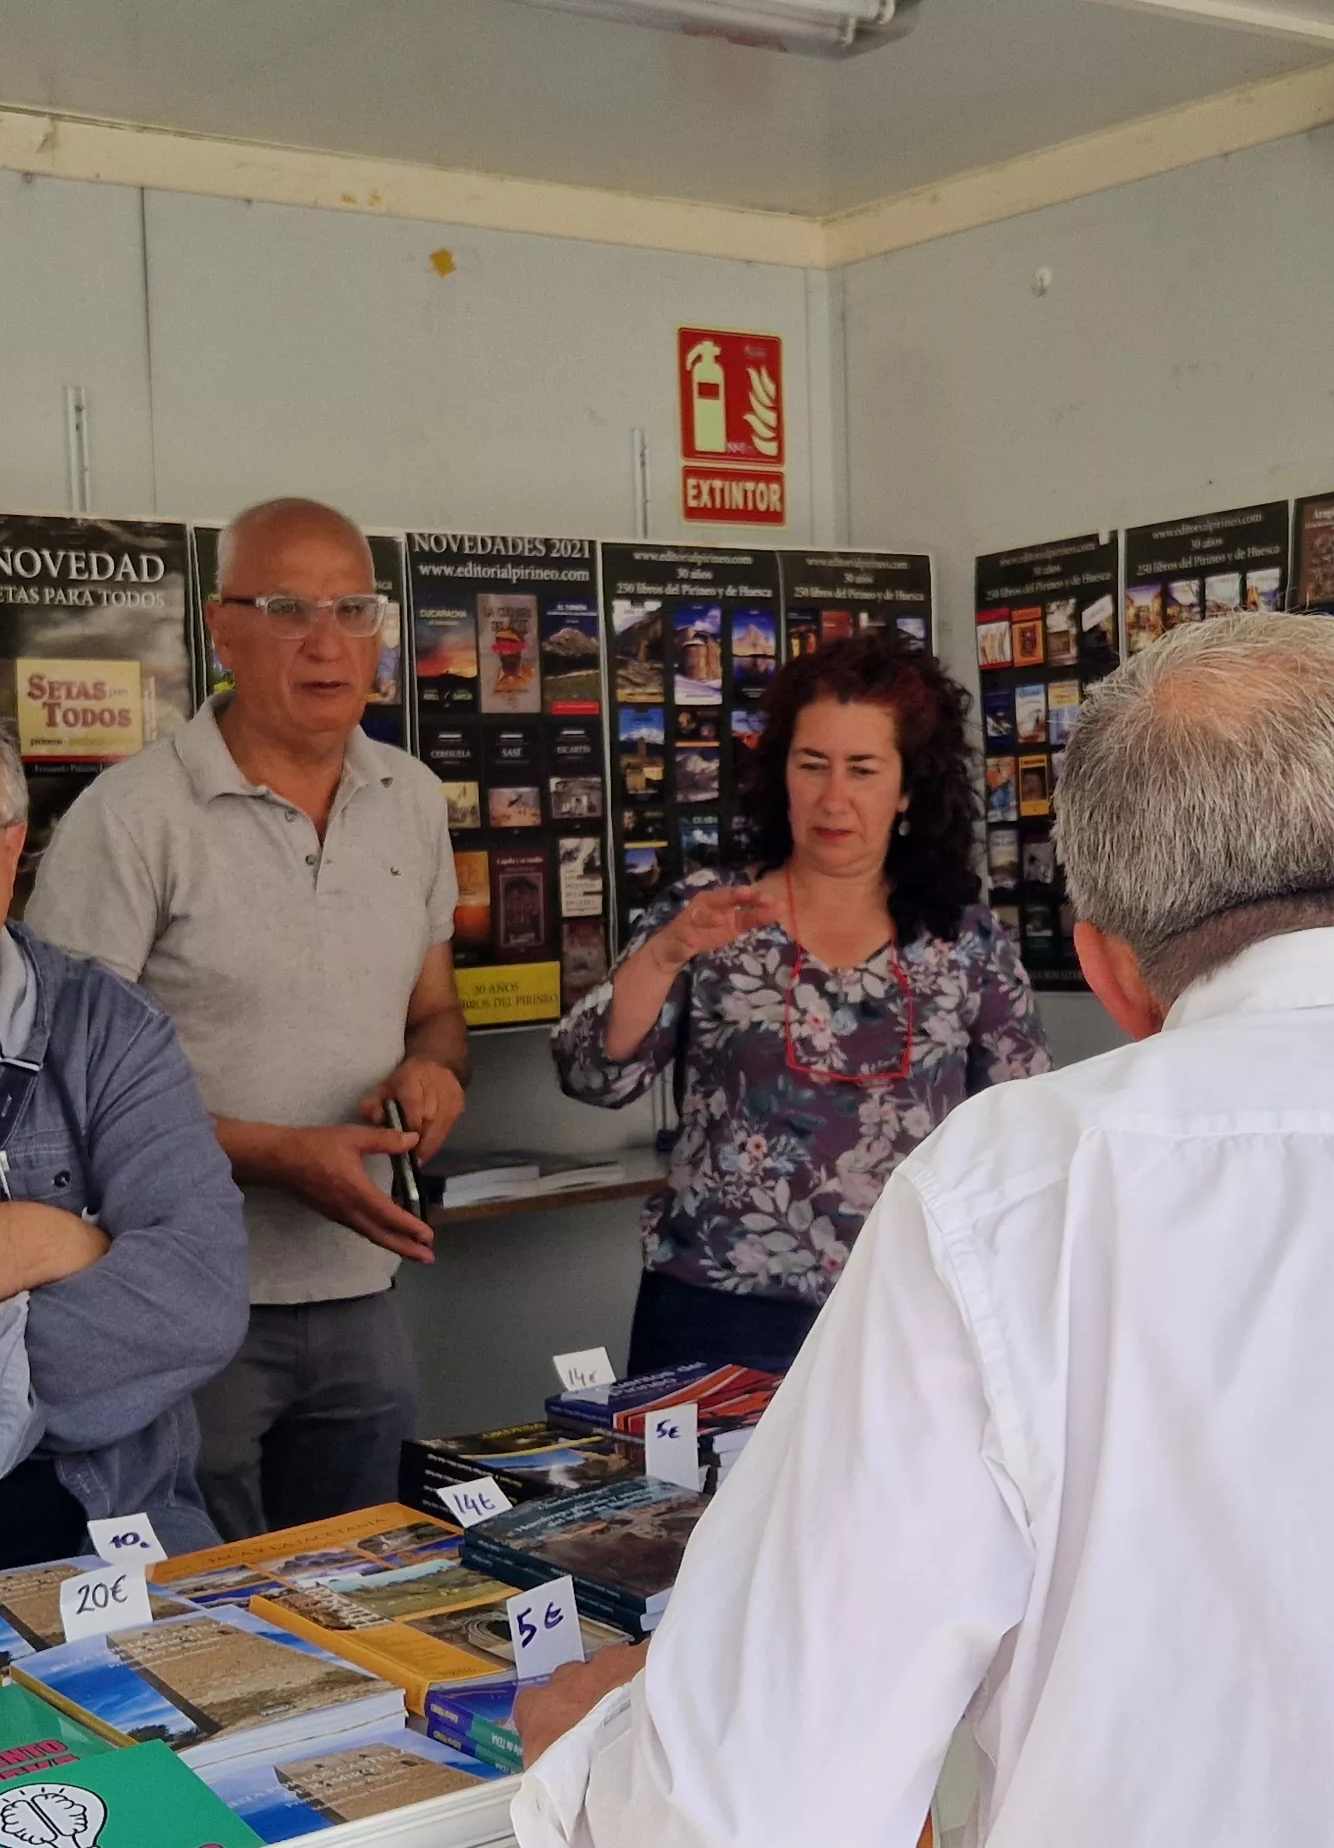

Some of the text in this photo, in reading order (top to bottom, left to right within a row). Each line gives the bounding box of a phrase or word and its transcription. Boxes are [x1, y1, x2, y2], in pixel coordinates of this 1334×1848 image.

[687, 479, 782, 512] EXTINTOR
[1152, 512, 1263, 541] www.editorialpirineo.com
[414, 533, 591, 558] NOVEDADES 2021
[1201, 537, 1224, 550] años
[633, 551, 754, 565] www.editorialpirineo.com
[1153, 558, 1178, 574] libros
[1178, 556, 1192, 570] del
[1194, 552, 1226, 568] Pirineo
[1234, 548, 1246, 561] de
[1247, 544, 1281, 559] Huesca
[418, 562, 590, 584] www.editorialpirineo.com
[676, 568, 714, 581] 30 años
[43, 586, 94, 607] PARA
[98, 588, 166, 610] TODOS
[616, 583, 634, 595] 250
[636, 583, 664, 596] libros
[666, 583, 680, 596] del
[682, 584, 717, 597] Pirineo
[725, 585, 738, 598] de
[739, 585, 773, 598] Huesca
[475, 986, 486, 996] 30
[515, 992, 559, 1008] PIRINEO
[76, 1575, 128, 1615] 20€
[517, 1601, 564, 1648] 5€
